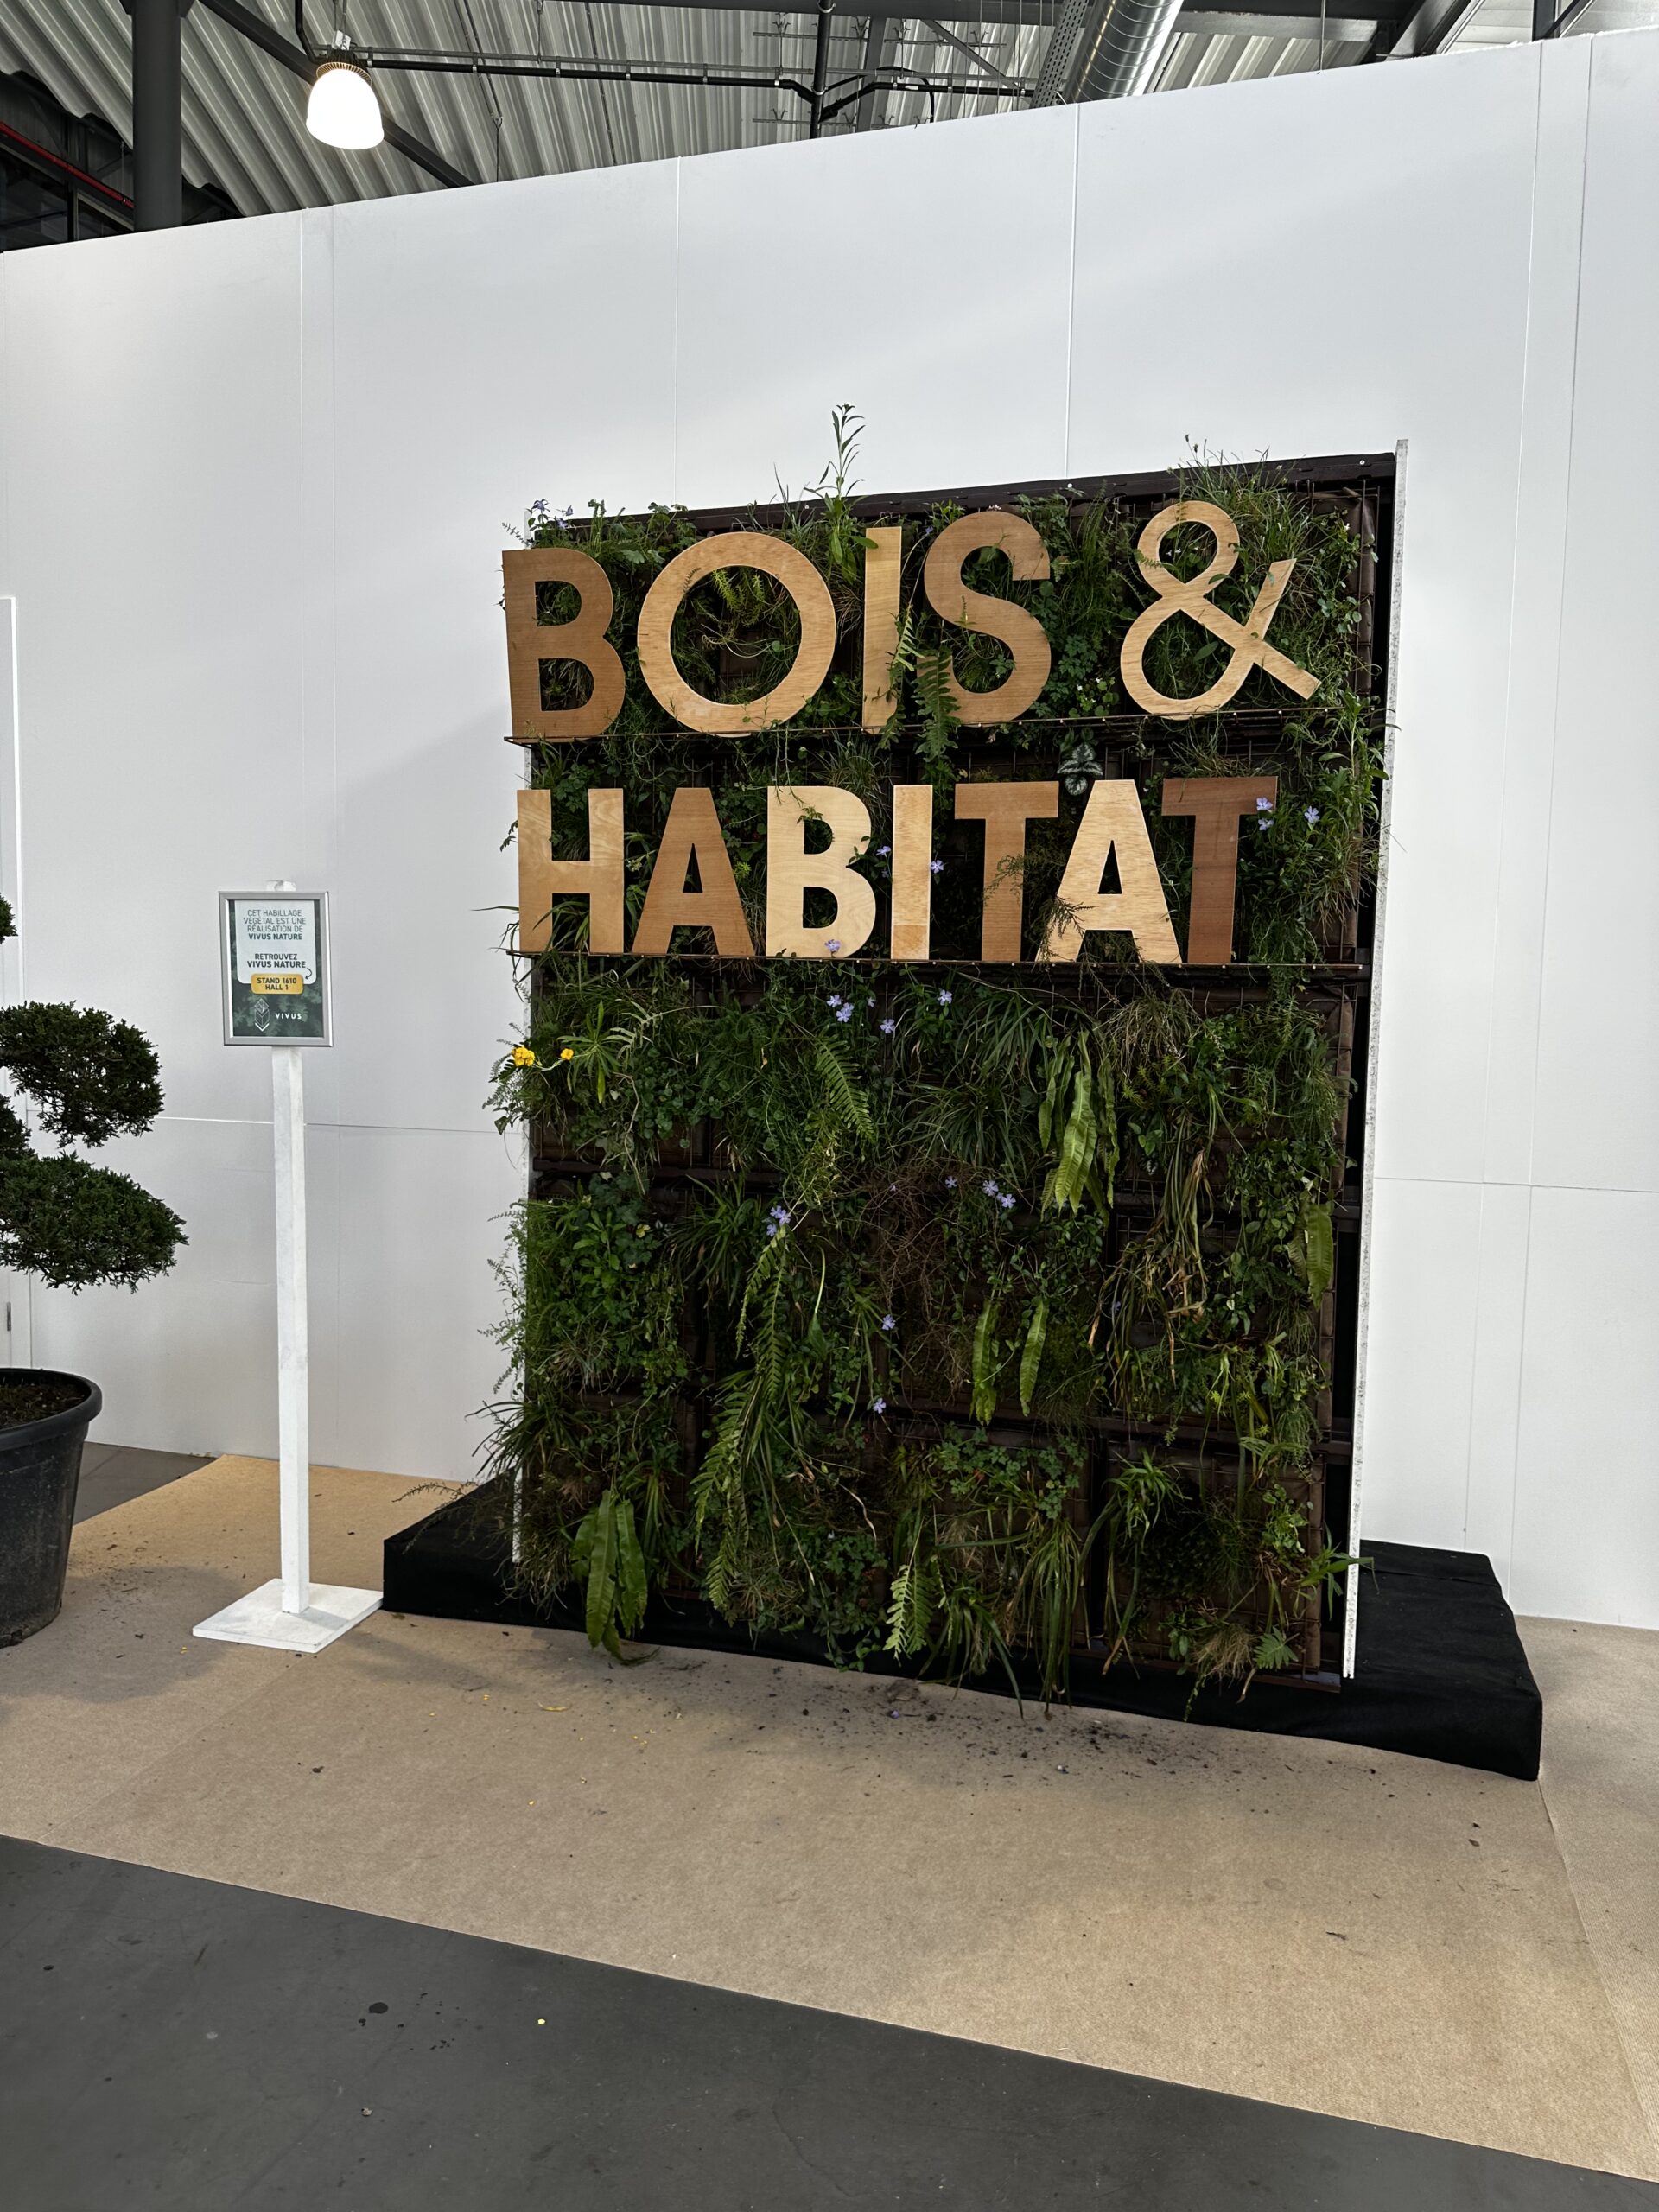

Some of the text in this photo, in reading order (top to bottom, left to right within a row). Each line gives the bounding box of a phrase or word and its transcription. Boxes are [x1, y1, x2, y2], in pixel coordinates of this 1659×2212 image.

[502, 500, 1320, 737] BOIS &
[517, 775, 1278, 965] HABITAT
[243, 916, 274, 925] VÉGÉTAL
[247, 924, 292, 932] RÉALISATION
